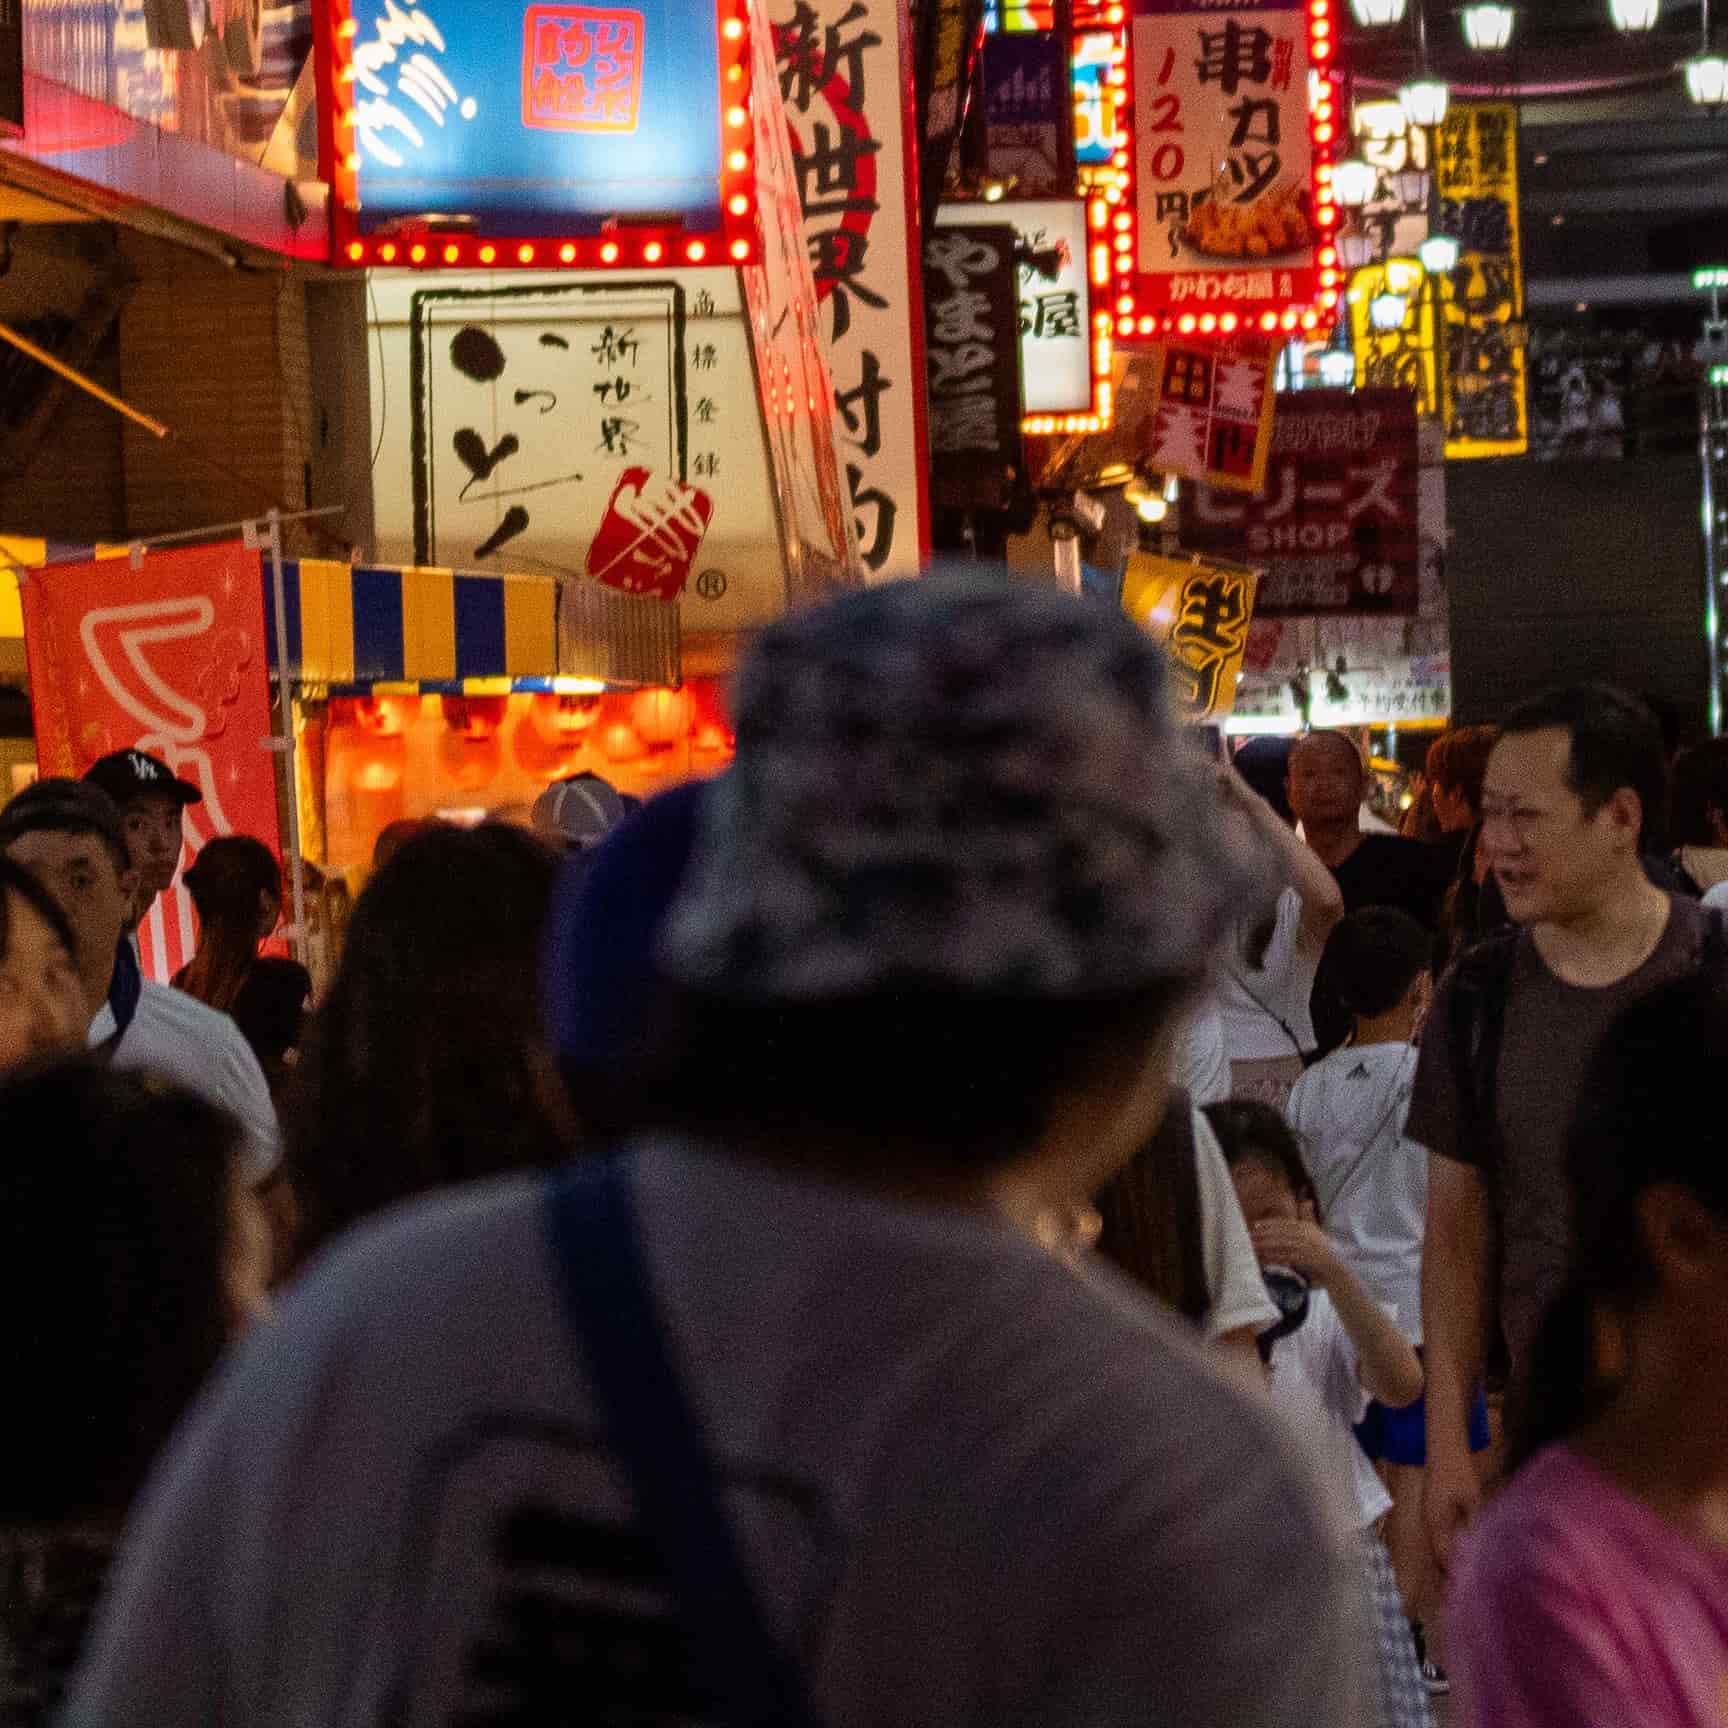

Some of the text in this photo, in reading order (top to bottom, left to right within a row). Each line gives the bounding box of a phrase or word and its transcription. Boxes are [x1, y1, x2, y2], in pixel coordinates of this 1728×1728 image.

[1193, 18, 1284, 204] 串カツ
[1244, 522, 1350, 551] SHOP
